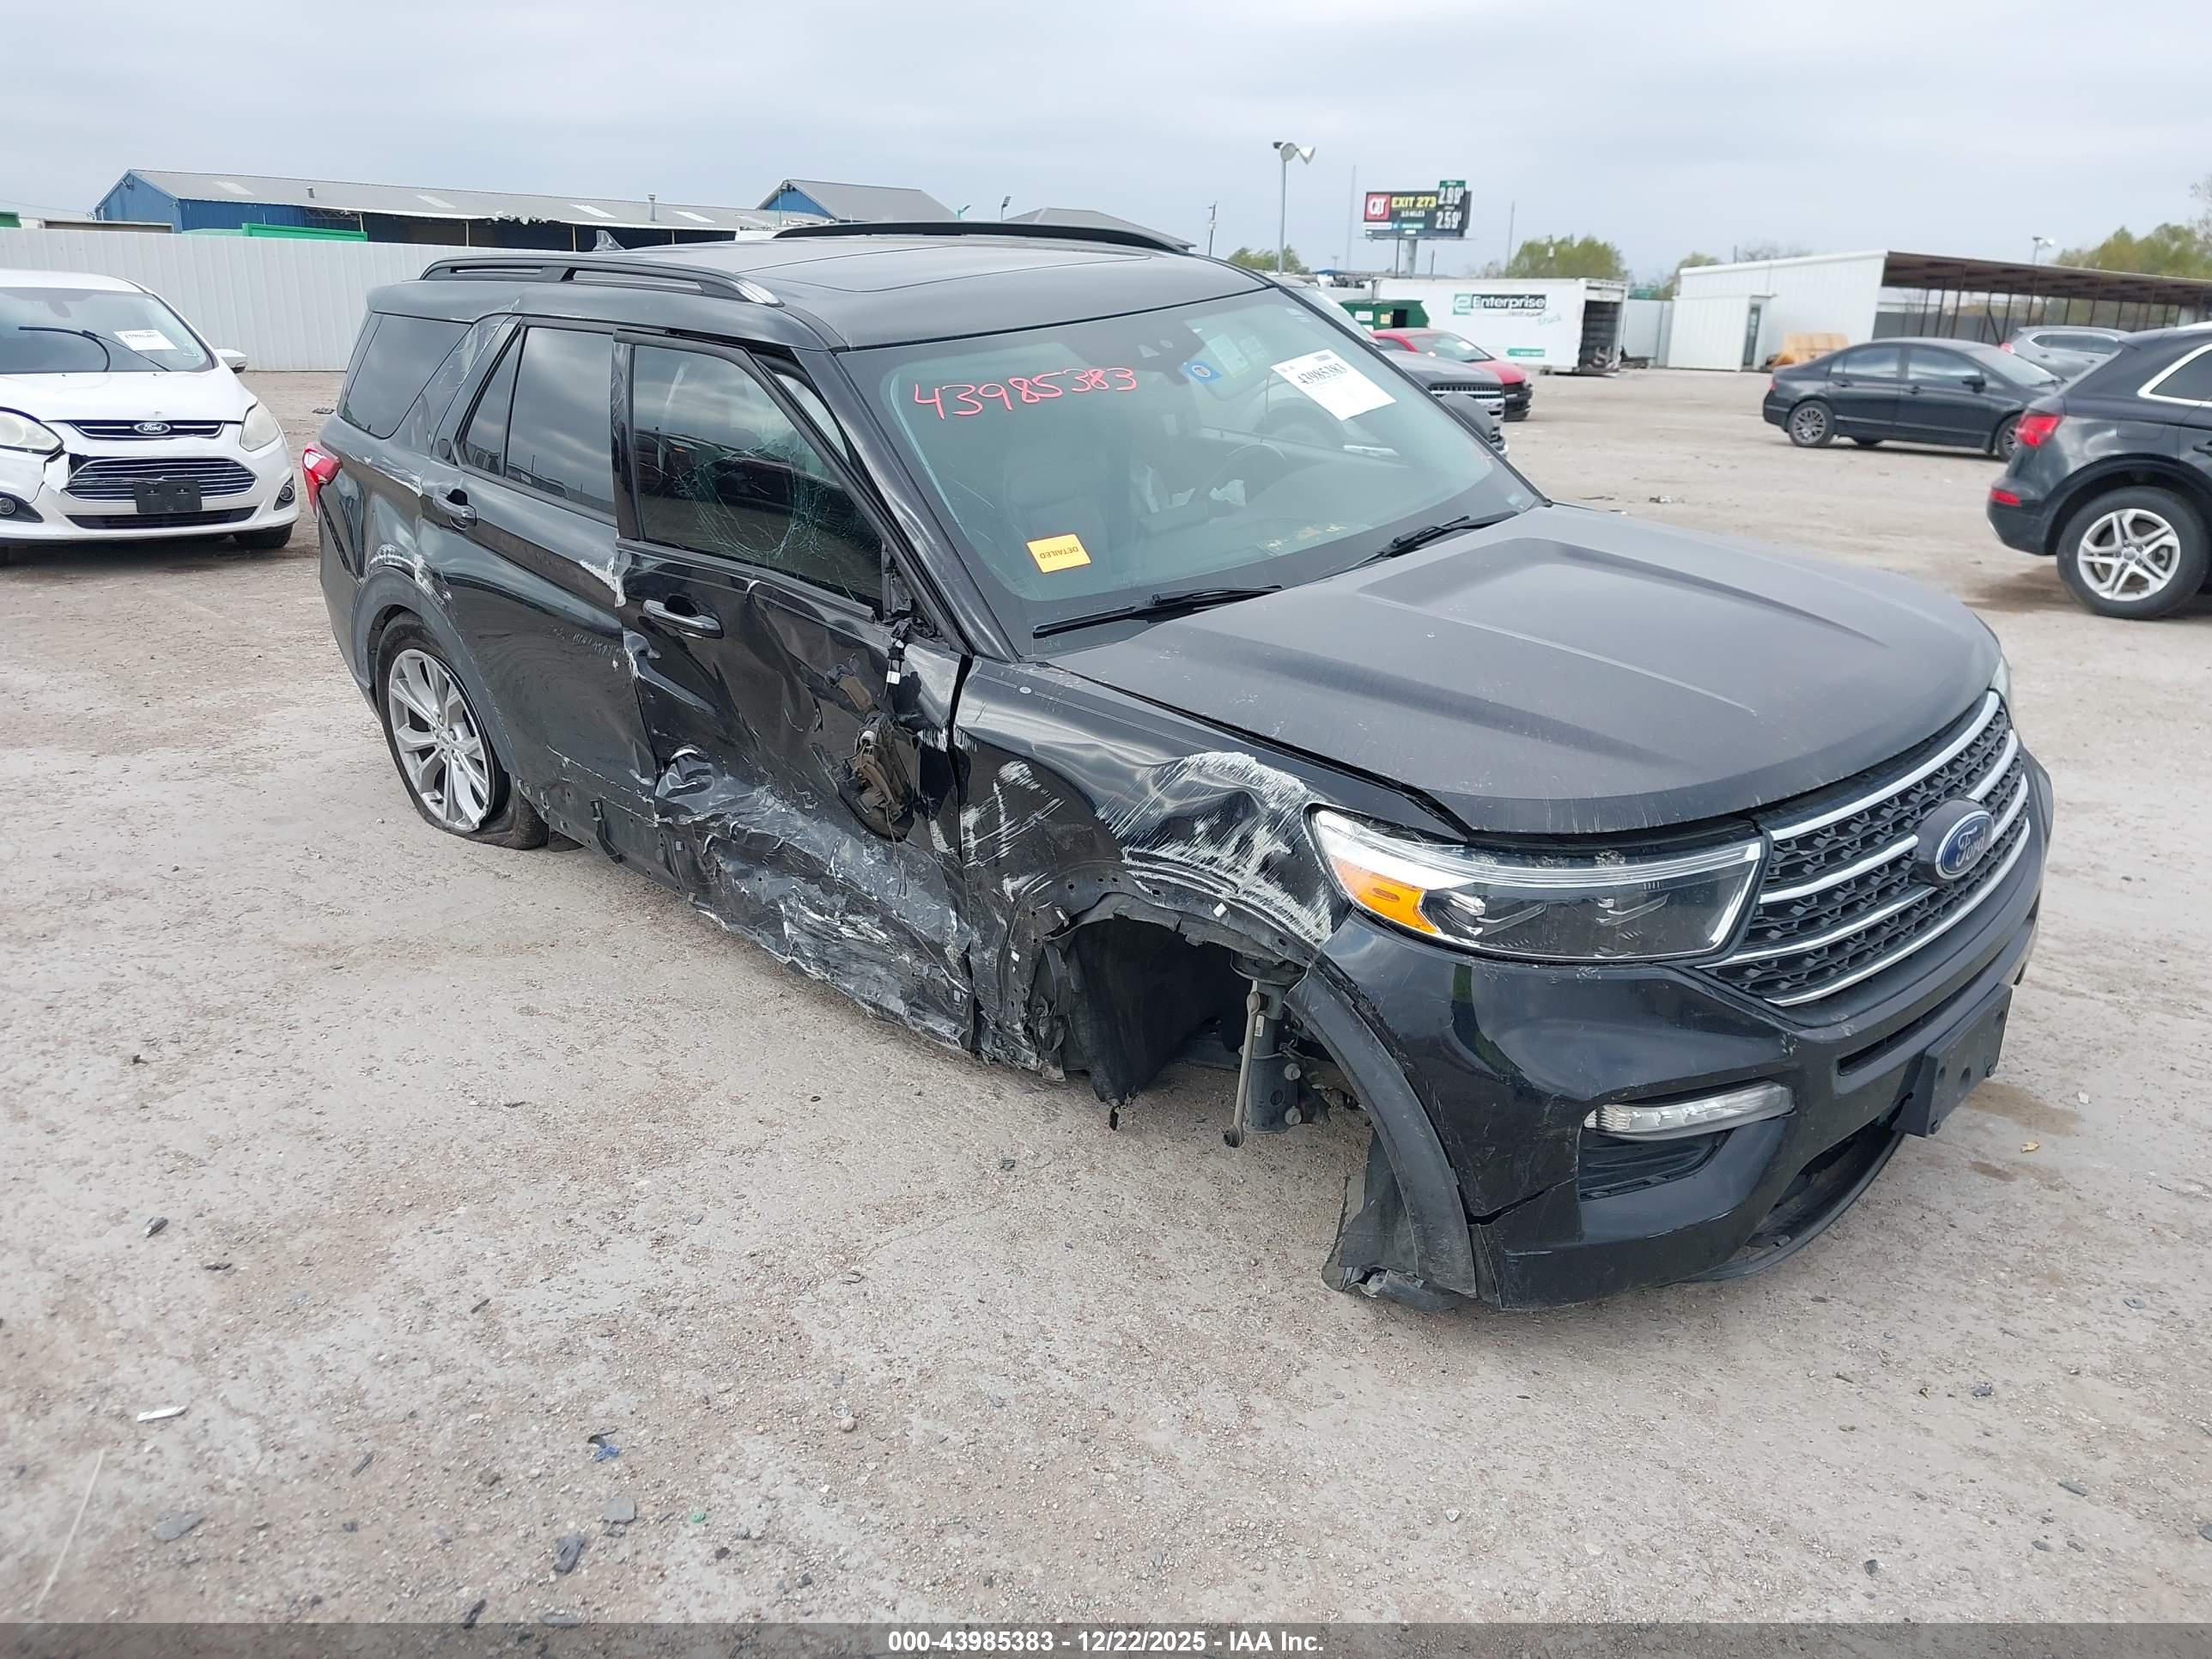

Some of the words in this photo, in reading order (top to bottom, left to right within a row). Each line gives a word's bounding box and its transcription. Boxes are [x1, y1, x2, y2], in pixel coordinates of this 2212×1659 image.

[1369, 198, 1387, 216] QT
[1391, 197, 1415, 208] EXIT
[1416, 196, 1437, 208] 273
[1472, 295, 1546, 311] Enterprise
[914, 368, 1138, 419] 43985383
[1039, 546, 1079, 559] DETAILED
[1955, 824, 1986, 867] Ford
